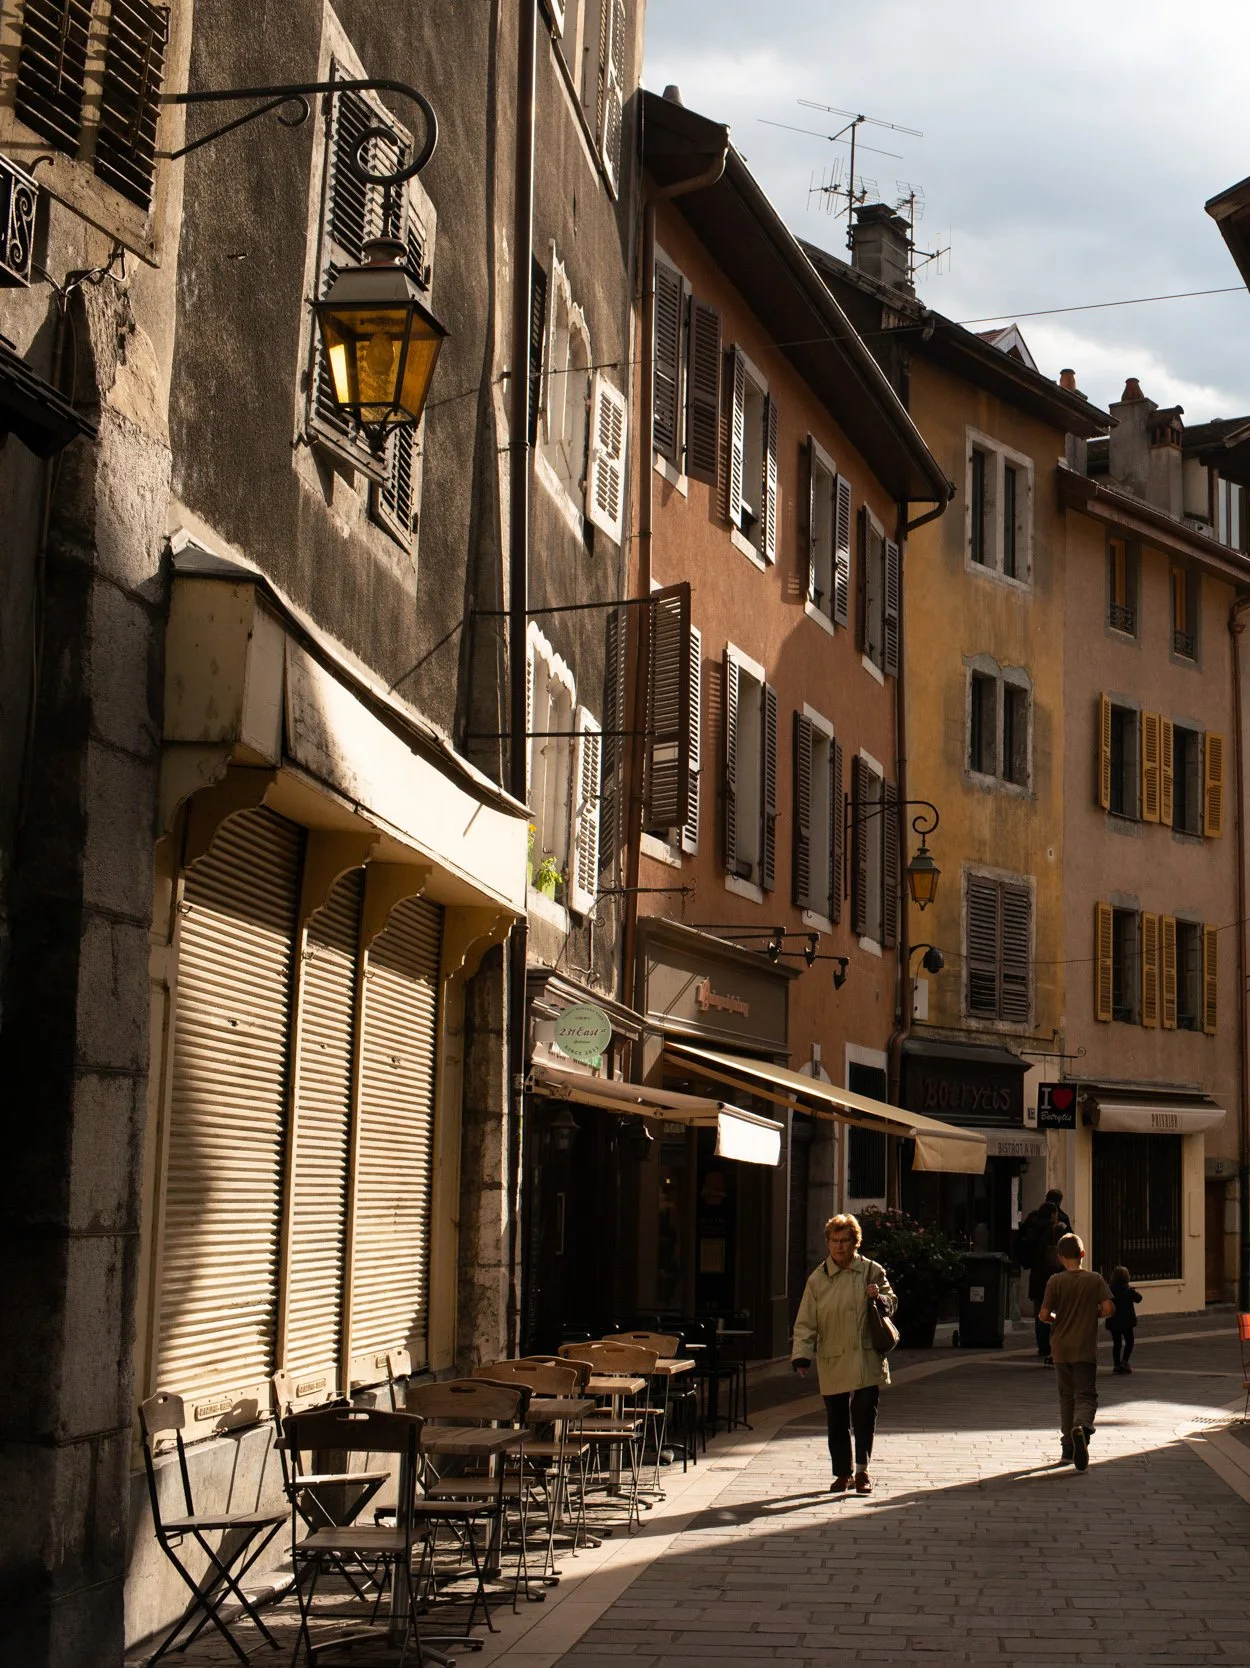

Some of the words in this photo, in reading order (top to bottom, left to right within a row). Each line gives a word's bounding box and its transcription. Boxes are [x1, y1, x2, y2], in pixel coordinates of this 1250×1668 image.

[577, 1027, 599, 1036] East
[923, 1076, 1011, 1111] Botrytis
[1041, 1087, 1052, 1110] I
[1040, 1110, 1073, 1123] Botrytis
[997, 1142, 1022, 1155] BISTROT
[1030, 1143, 1041, 1155] VIN
